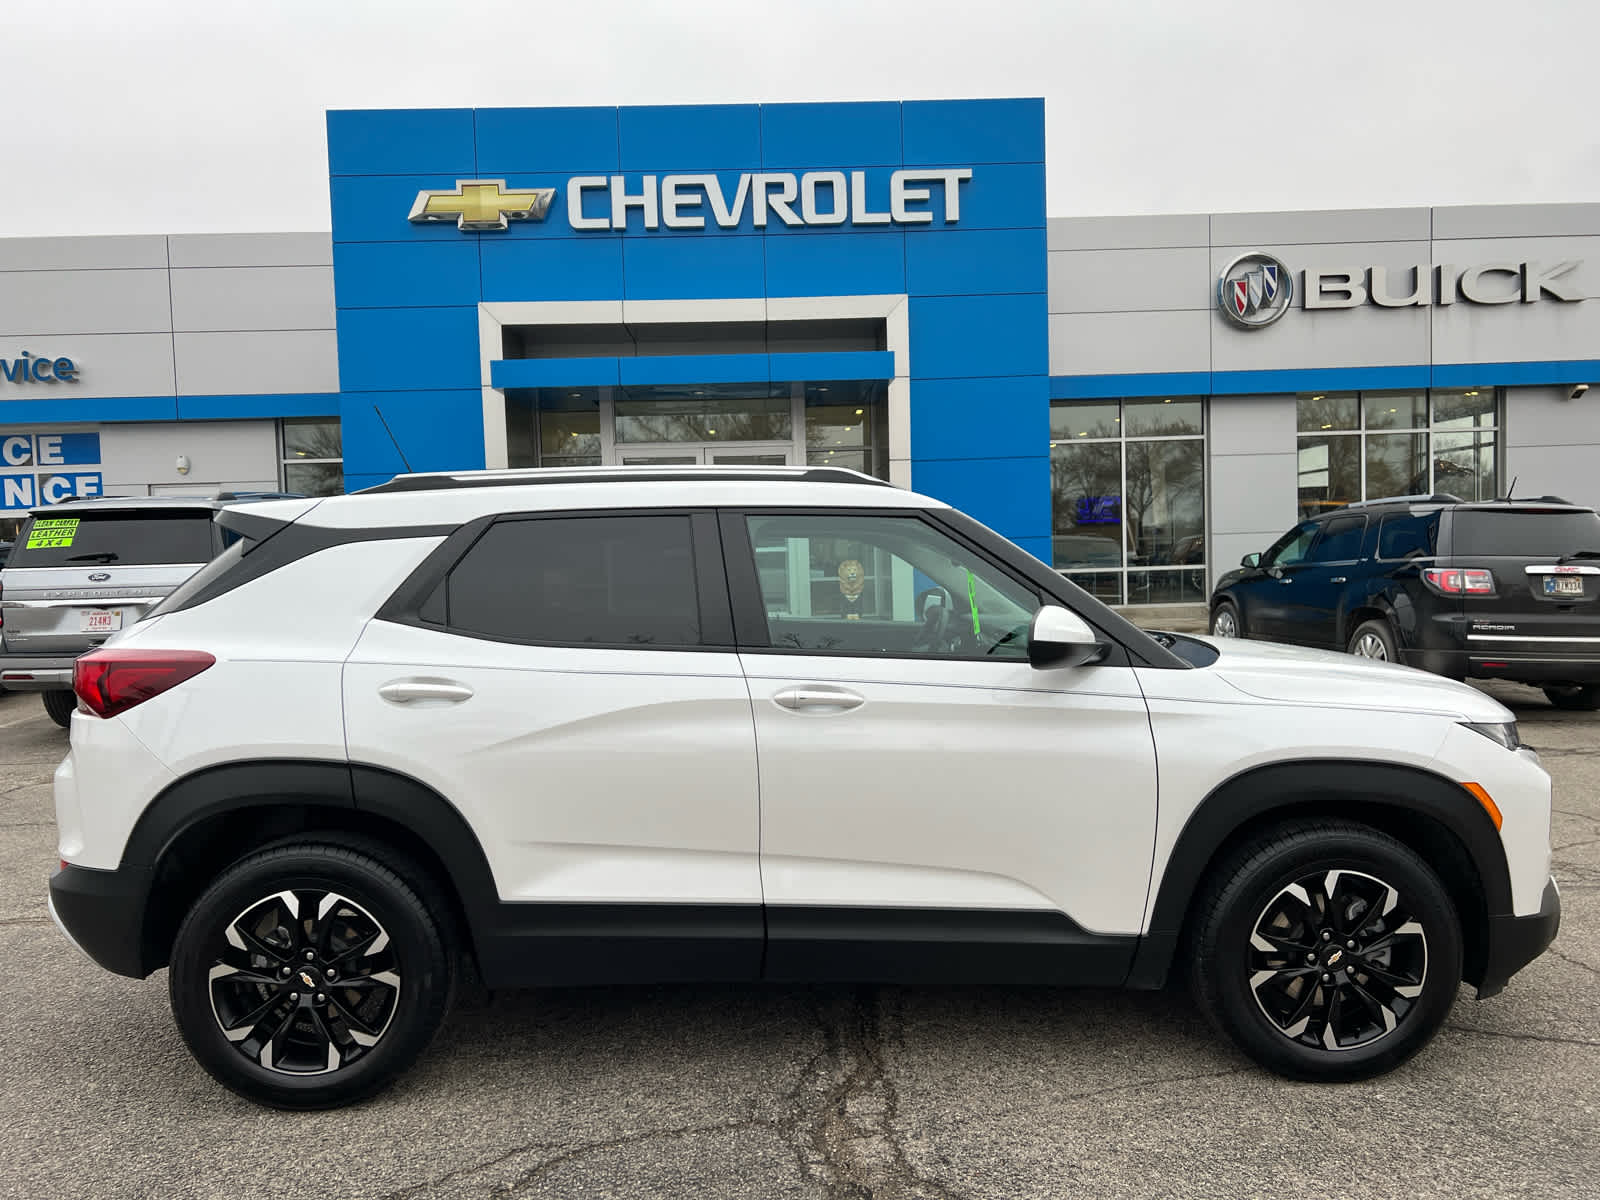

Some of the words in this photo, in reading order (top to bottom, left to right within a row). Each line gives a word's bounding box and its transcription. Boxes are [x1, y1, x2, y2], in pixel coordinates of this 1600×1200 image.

[567, 168, 972, 230] CHEVROLET
[1301, 259, 1584, 310] BUICK
[0, 350, 76, 383] vice
[2, 435, 64, 466] CE
[3, 475, 99, 506] NCE
[31, 529, 75, 538] LEATHER
